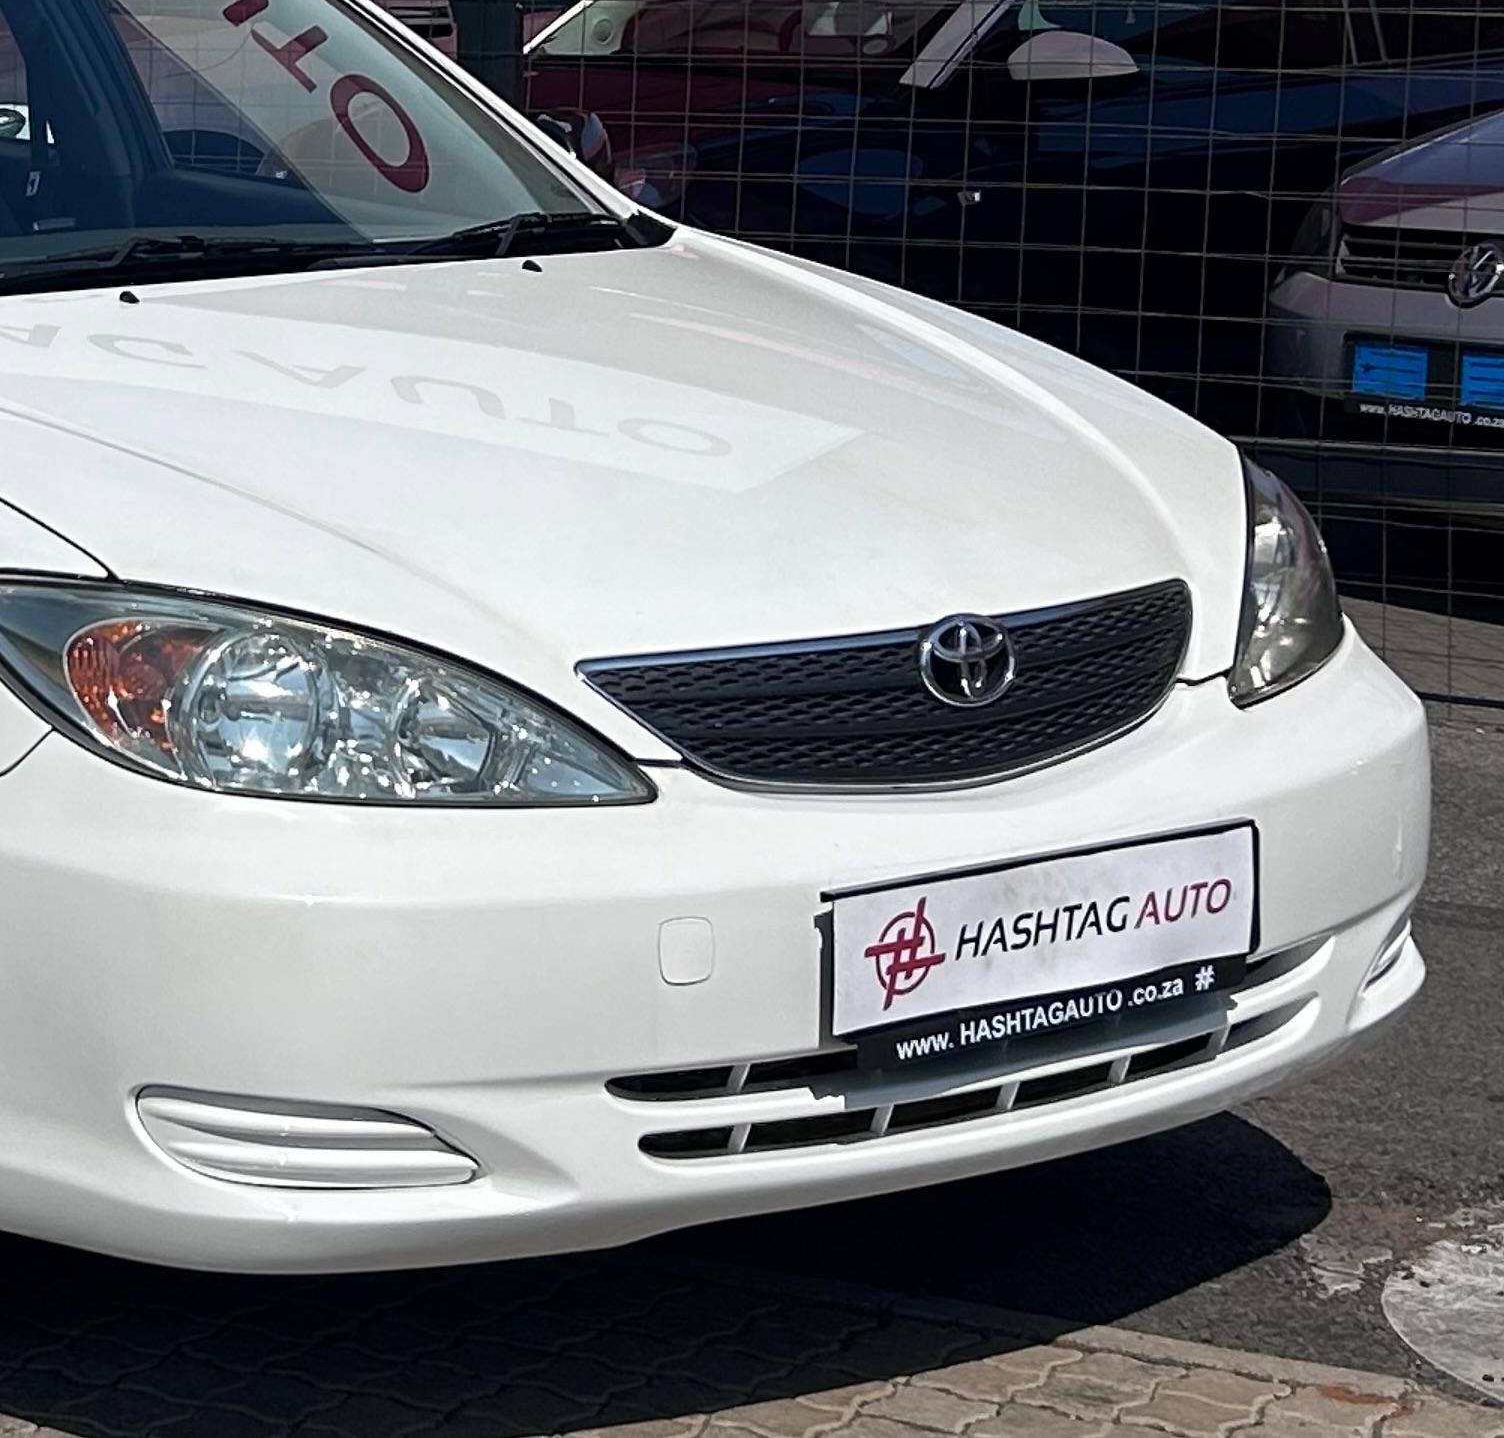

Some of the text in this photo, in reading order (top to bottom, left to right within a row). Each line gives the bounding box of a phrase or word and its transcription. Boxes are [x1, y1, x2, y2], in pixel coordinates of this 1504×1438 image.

[955, 878, 1232, 961] HASHTAG AUTO
[897, 1032, 954, 1060] www.
[960, 988, 1123, 1045] HASHTAGAUTO
[1128, 978, 1184, 1007] .co.za
